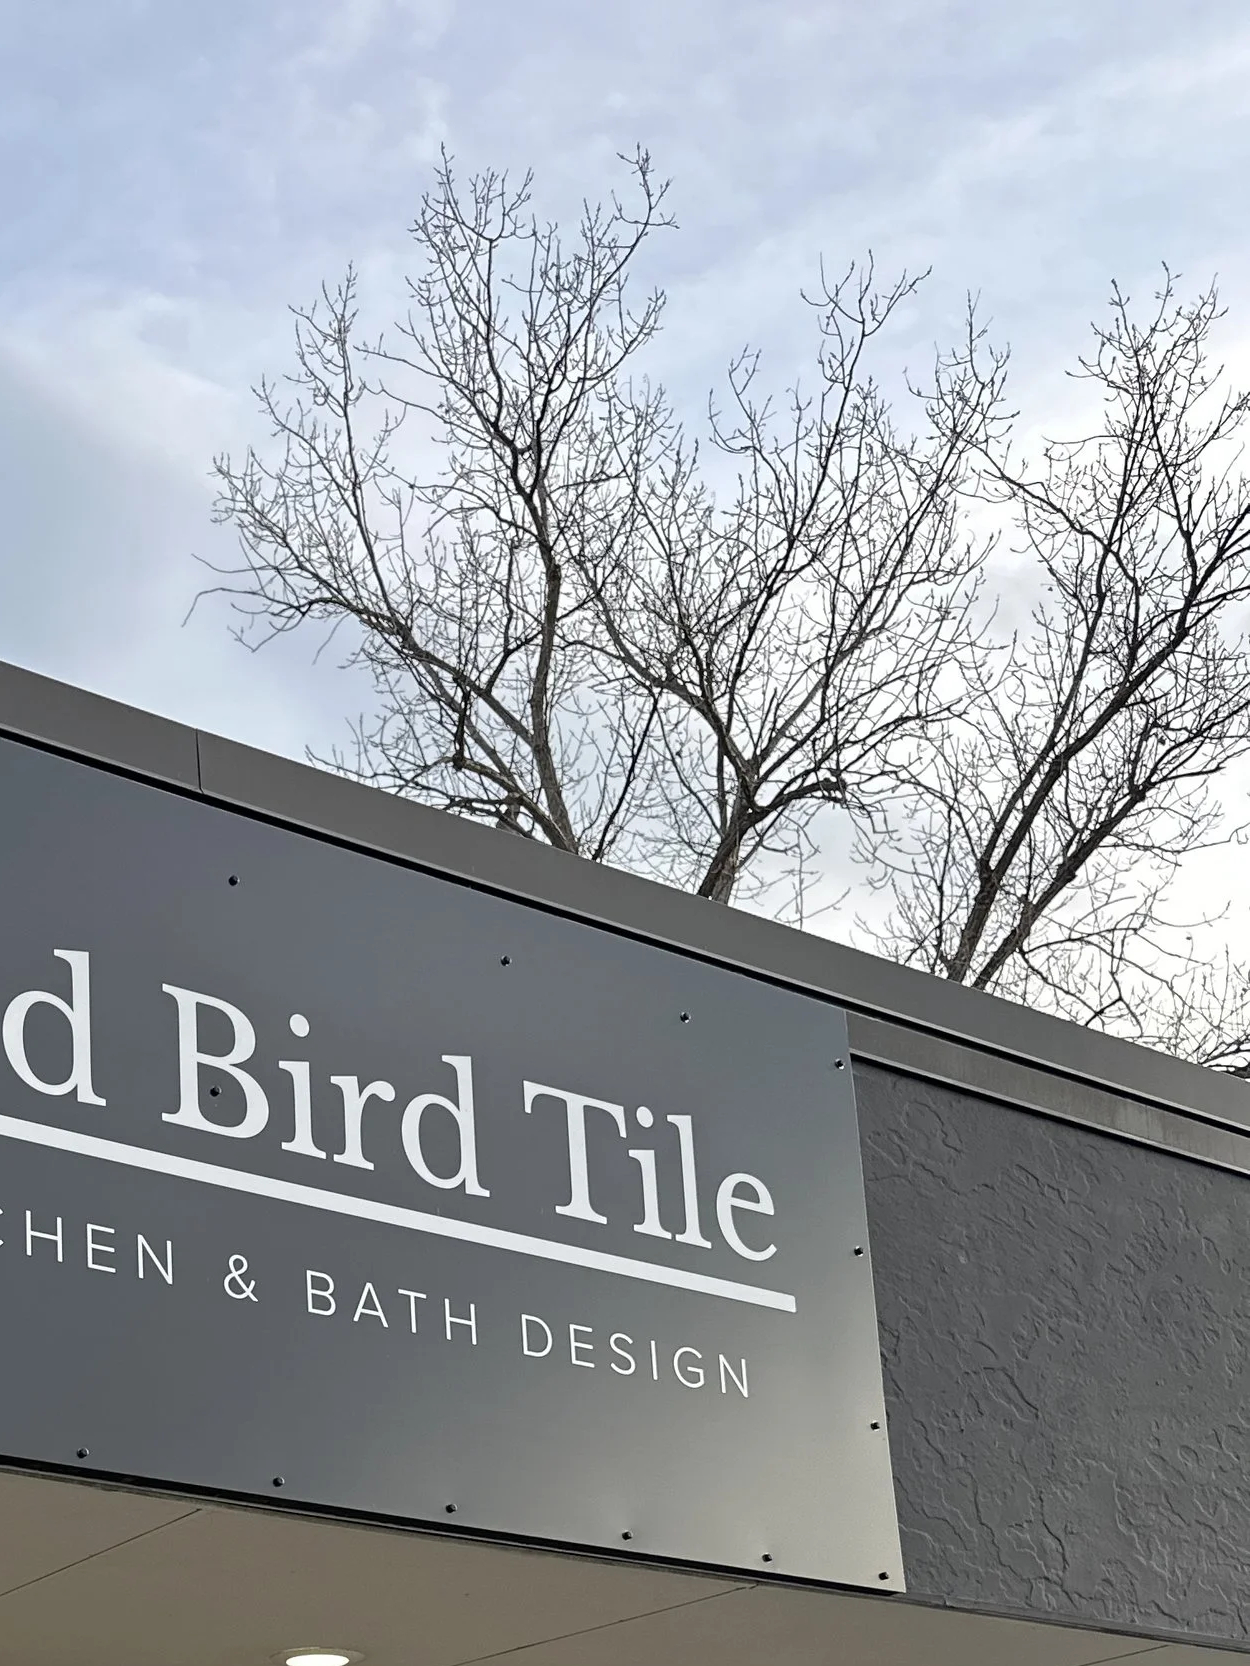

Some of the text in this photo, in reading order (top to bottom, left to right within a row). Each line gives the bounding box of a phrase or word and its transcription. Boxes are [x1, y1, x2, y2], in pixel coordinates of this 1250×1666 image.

[161, 983, 490, 1198] Bird
[523, 1080, 778, 1262] Tile
[223, 1254, 259, 1302] &
[306, 1269, 477, 1346] BATH
[521, 1313, 749, 1399] DESIGN
